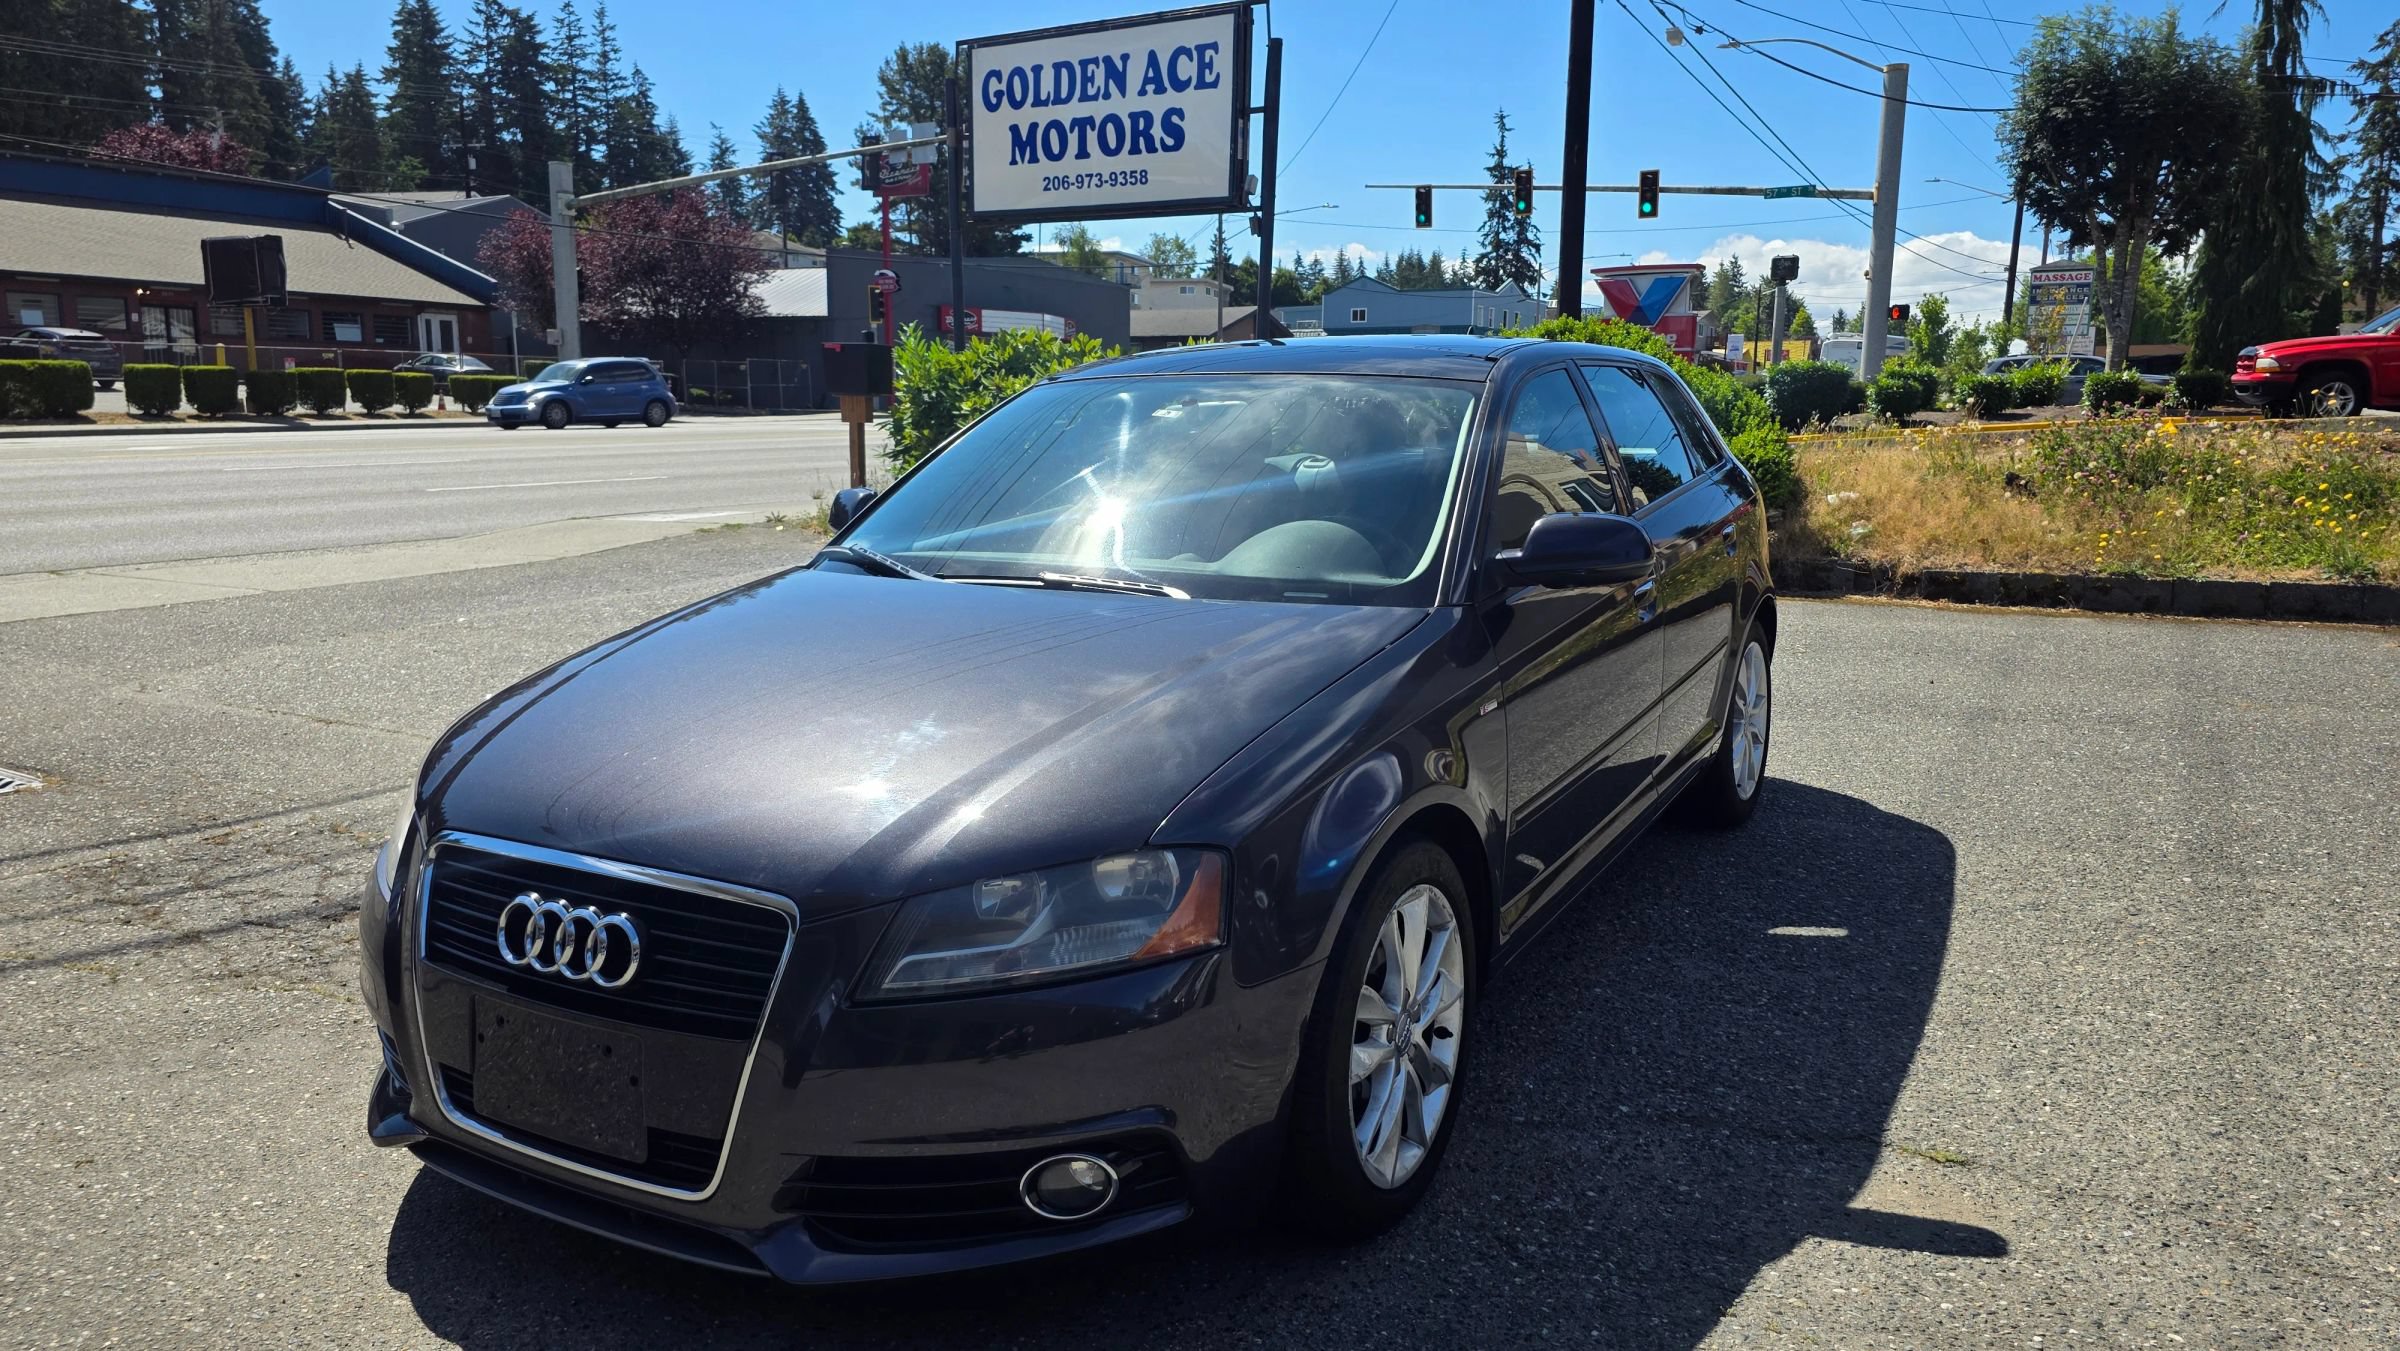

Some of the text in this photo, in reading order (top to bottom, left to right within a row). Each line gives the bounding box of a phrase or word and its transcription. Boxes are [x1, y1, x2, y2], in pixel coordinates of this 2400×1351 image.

[981, 41, 1221, 113] GOLDEN ACE
[1008, 107, 1186, 166] MOTORS
[1042, 169, 1149, 192] 206-973-9358
[2033, 272, 2092, 282] MASSAGE
